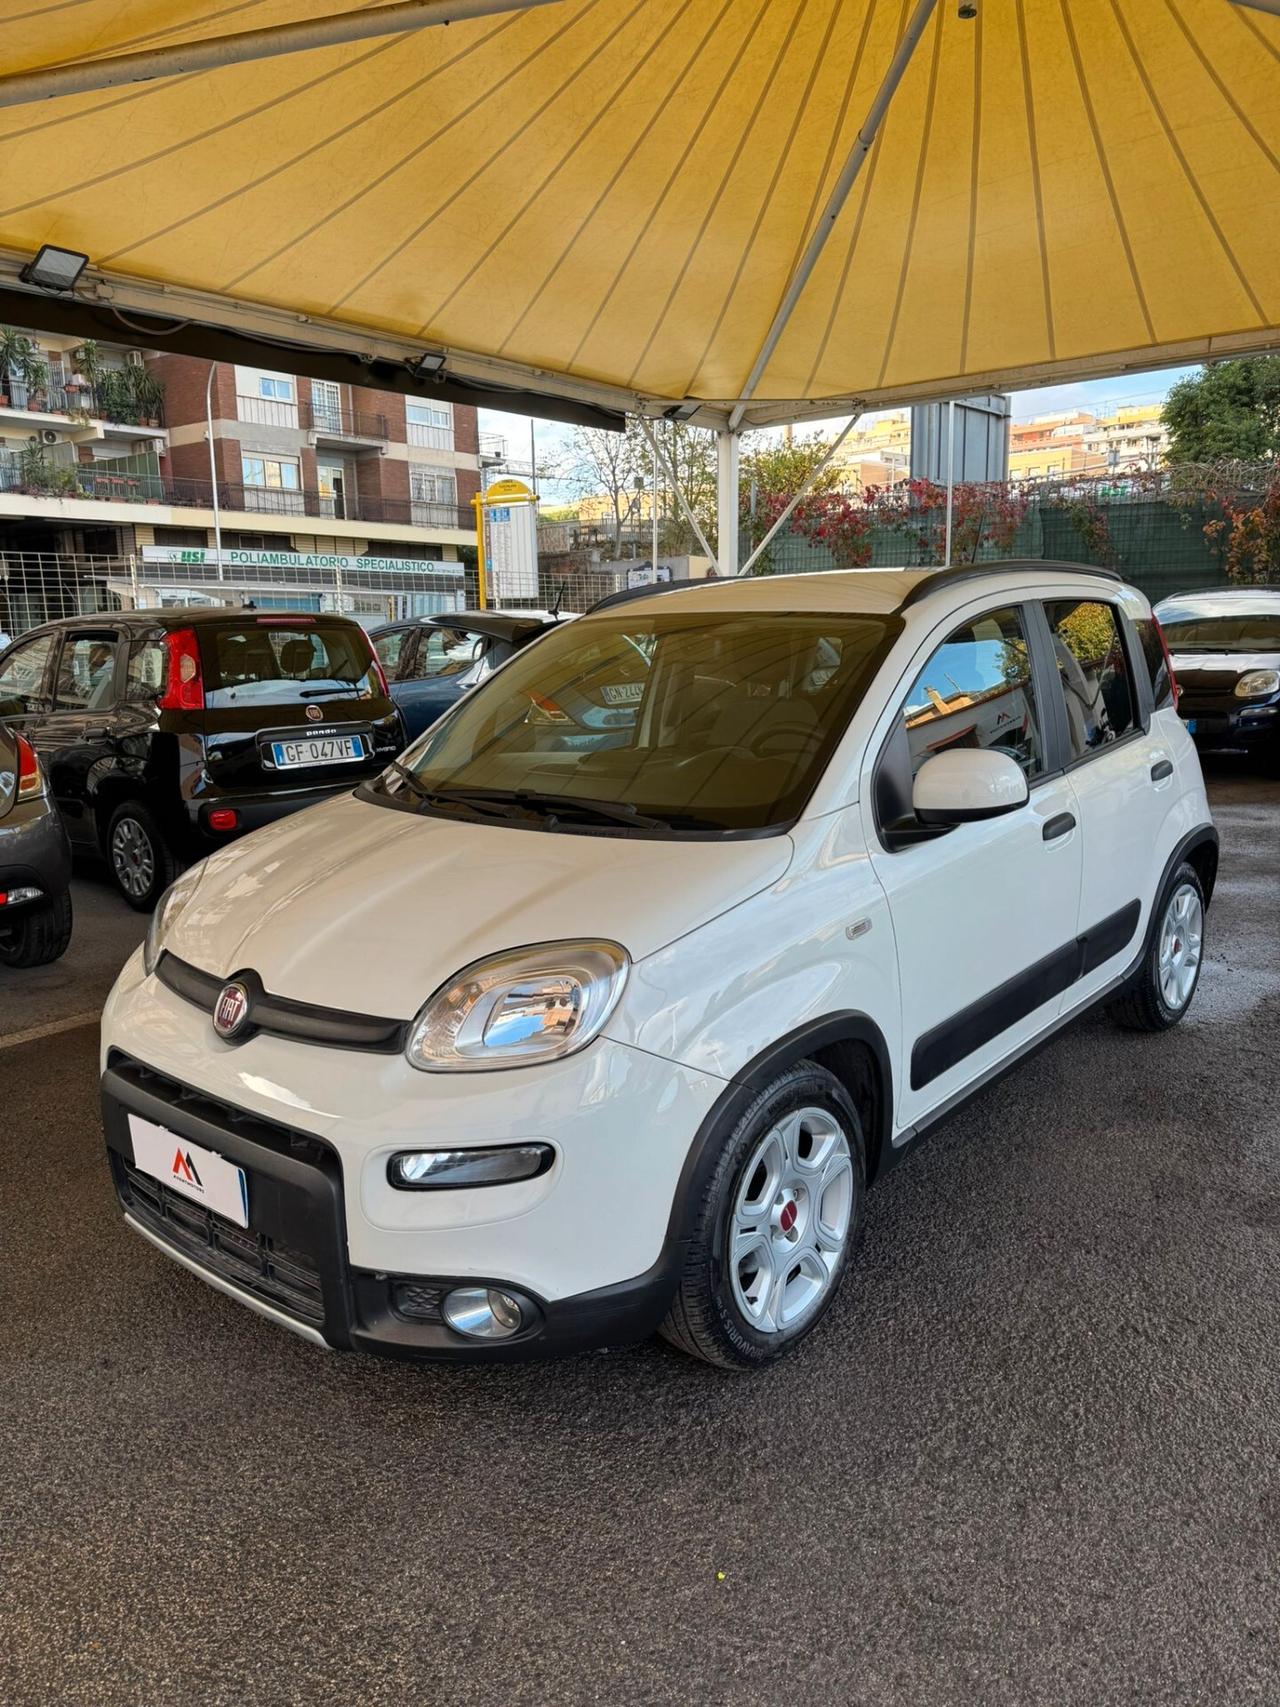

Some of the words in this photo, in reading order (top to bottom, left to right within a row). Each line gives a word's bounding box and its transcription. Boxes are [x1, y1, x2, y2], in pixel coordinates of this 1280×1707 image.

[230, 551, 349, 568] POLIAMBULATORIO
[356, 558, 434, 573] SPECIALISTICO
[285, 743, 303, 762] GF
[309, 739, 352, 760] 047VF
[219, 996, 241, 1022] FIAT
